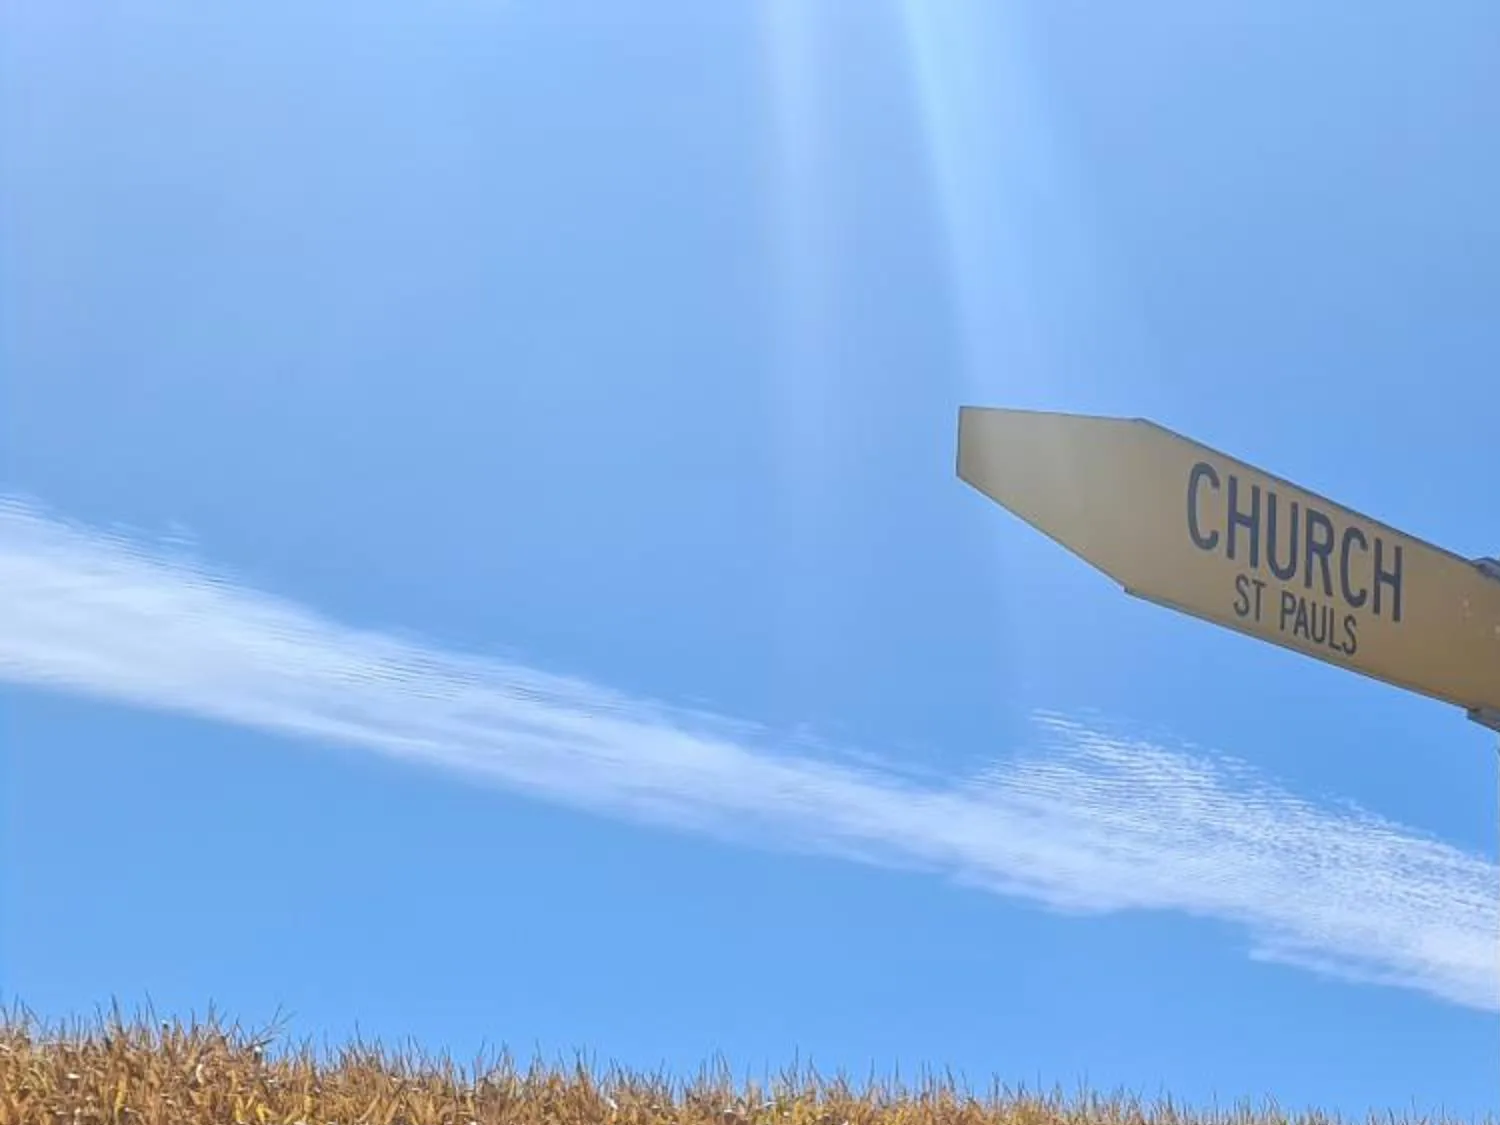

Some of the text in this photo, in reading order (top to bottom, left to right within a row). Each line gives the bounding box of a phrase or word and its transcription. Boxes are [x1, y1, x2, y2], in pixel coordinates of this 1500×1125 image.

[1187, 462, 1403, 622] CHURCH
[1233, 574, 1357, 656] ST PAULS
